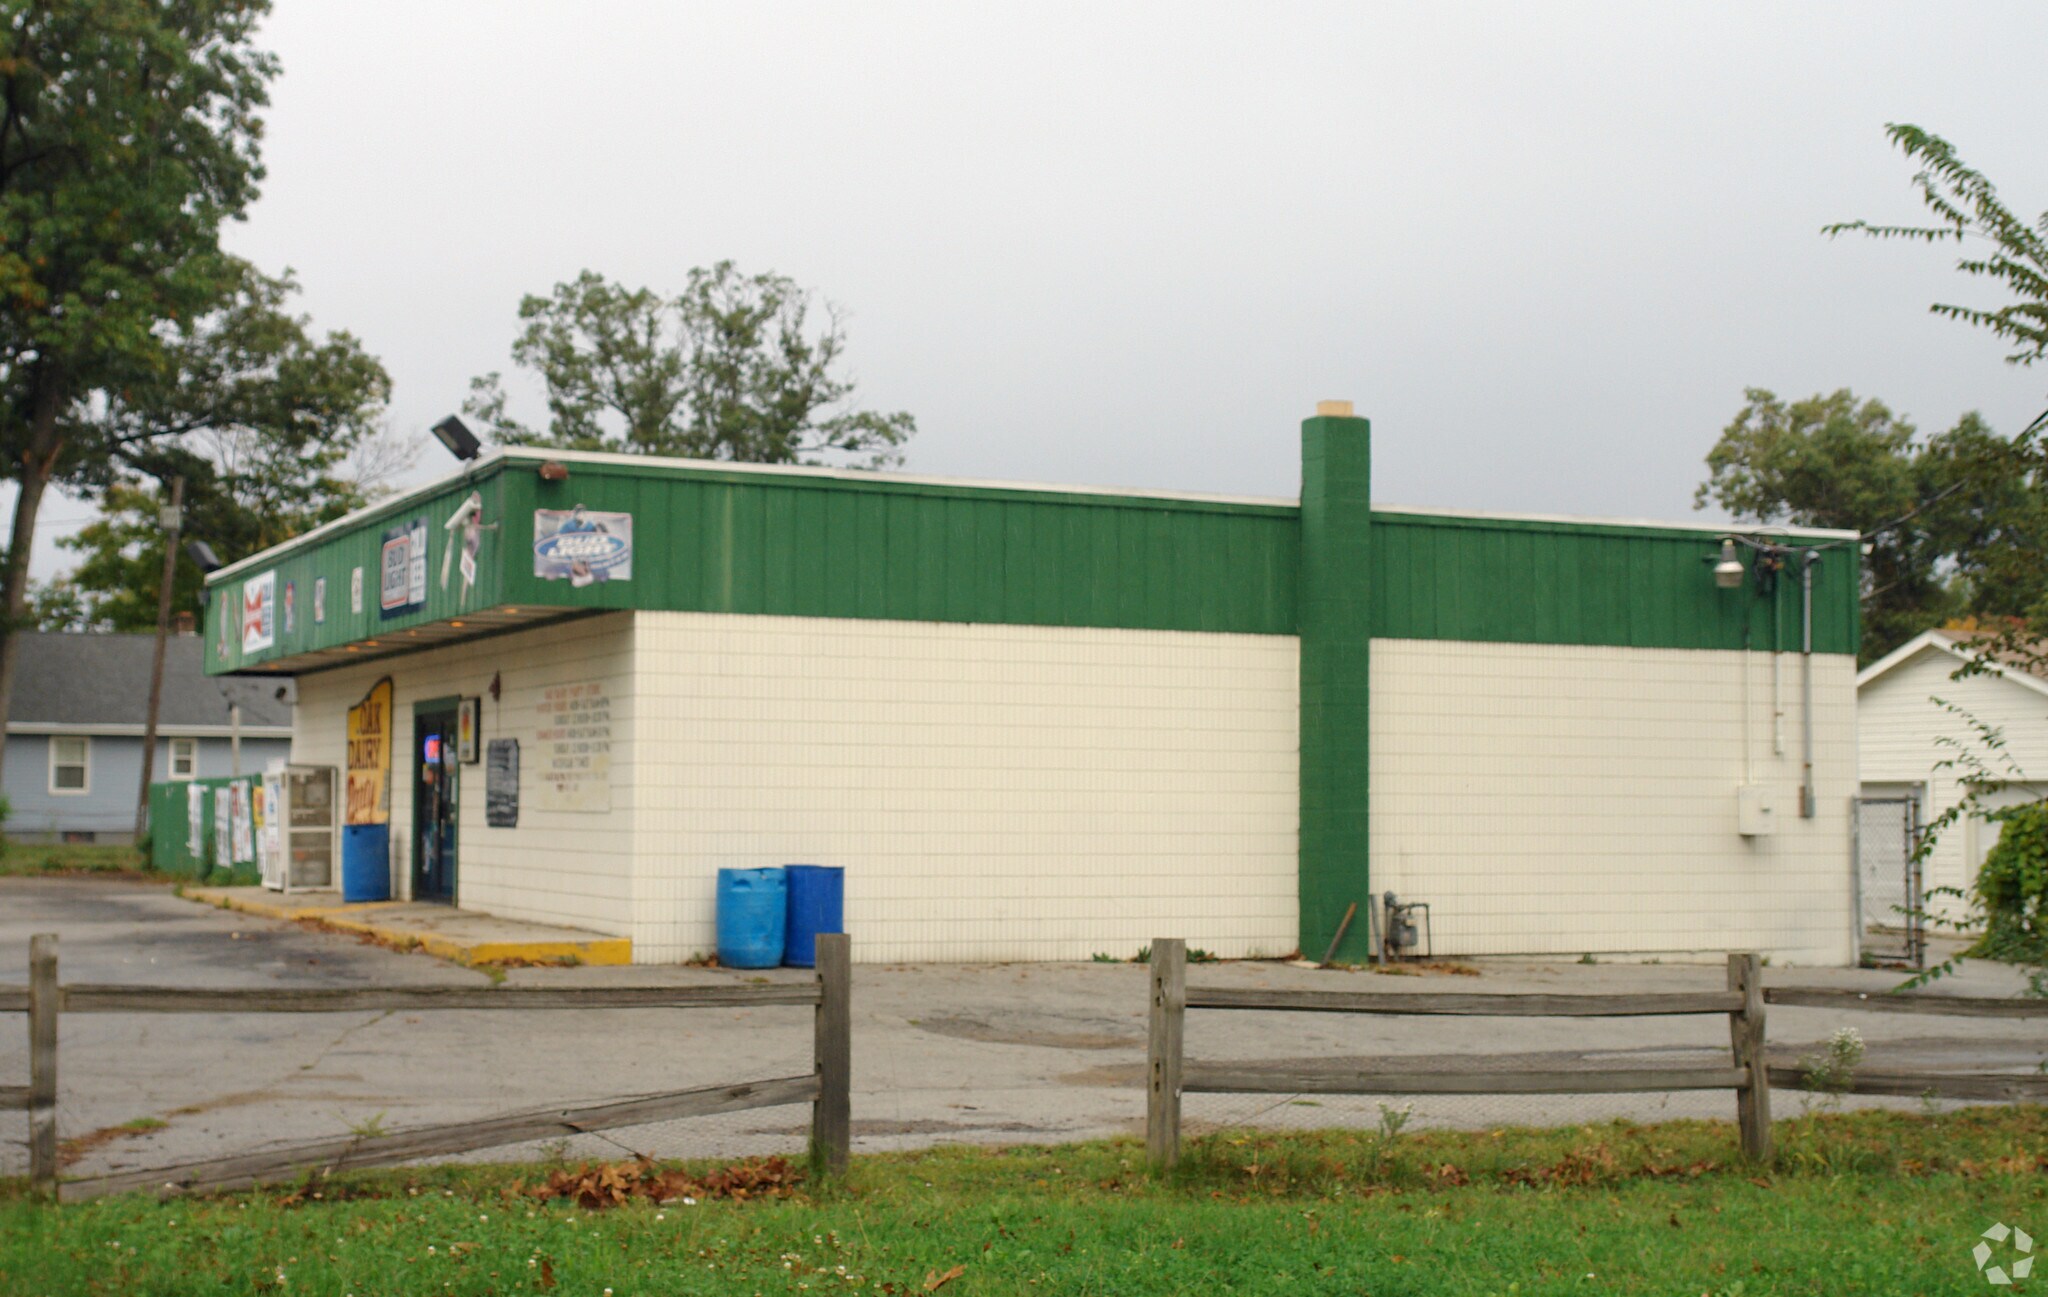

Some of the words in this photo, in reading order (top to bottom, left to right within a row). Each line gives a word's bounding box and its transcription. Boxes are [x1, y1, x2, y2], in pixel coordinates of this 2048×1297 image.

[388, 547, 404, 568] BUD
[384, 567, 406, 591] LIGHT
[360, 702, 381, 735] OAK
[348, 737, 381, 770] DAIRY
